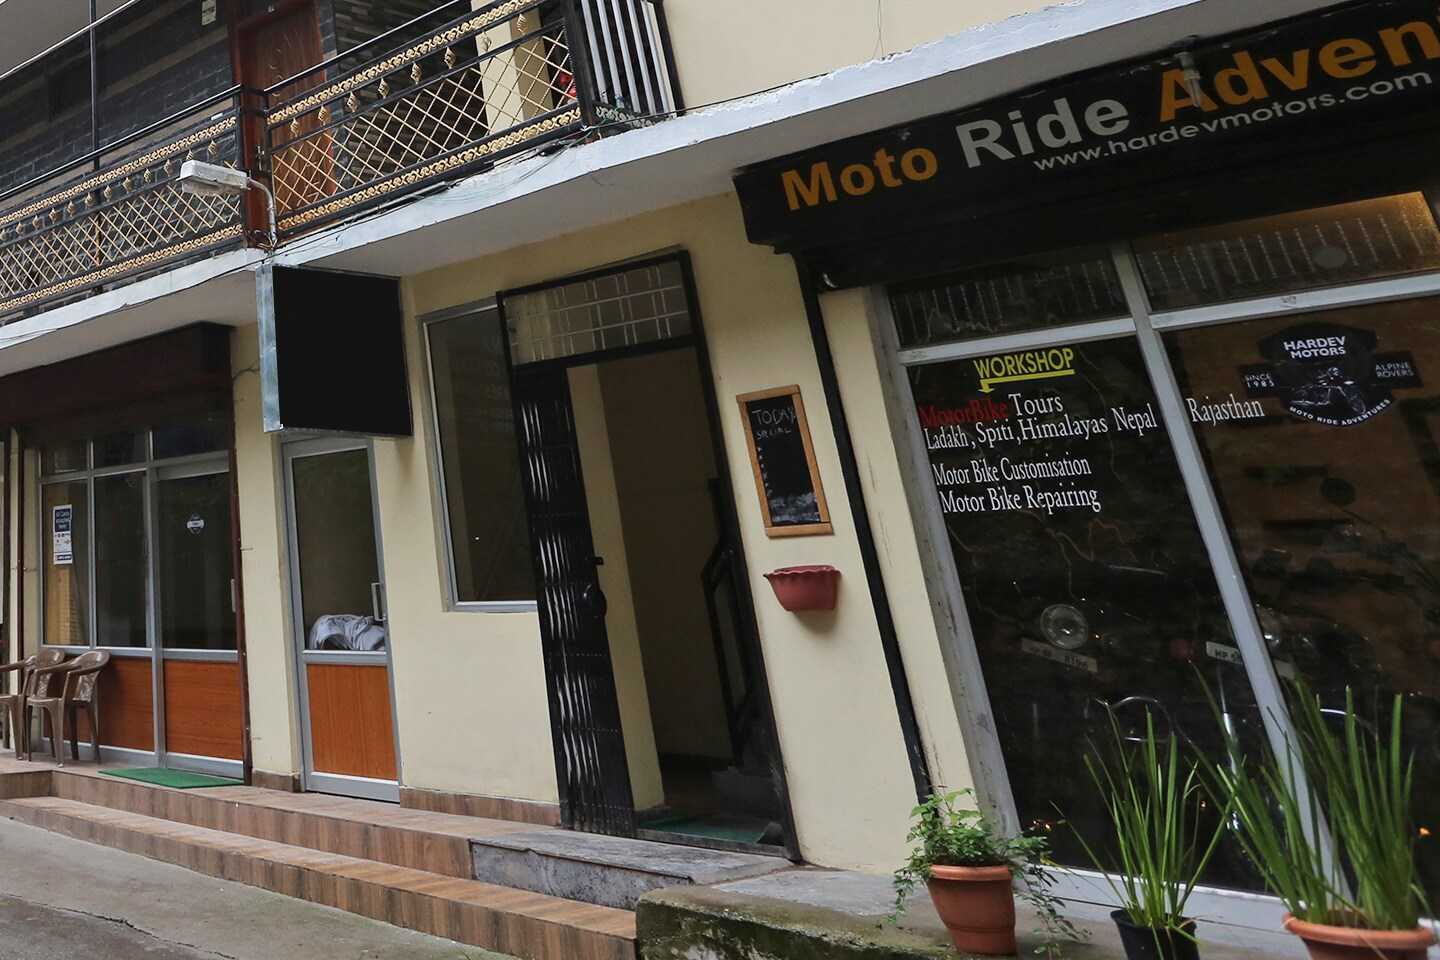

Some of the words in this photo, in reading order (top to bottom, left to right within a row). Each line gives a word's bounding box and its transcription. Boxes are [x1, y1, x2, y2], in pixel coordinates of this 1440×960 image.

[780, 147, 938, 211] Moto
[955, 95, 1130, 168] Ride
[1159, 12, 1440, 122] Adven
[1033, 72, 1432, 171] www.hardevmotors.com
[1283, 336, 1346, 351] HARDEV
[1290, 346, 1346, 359] MOTORS
[973, 348, 1074, 378] WORKSHOP
[1008, 393, 1064, 417] Tours
[1111, 403, 1158, 436] Nepal
[1186, 393, 1265, 426] Rajasthan
[932, 463, 970, 486] Motor
[970, 458, 998, 483] Bike
[1000, 452, 1092, 480] Customisation
[939, 491, 985, 513] Motor
[987, 486, 1022, 511] Bike
[1023, 482, 1101, 515] Repairing
